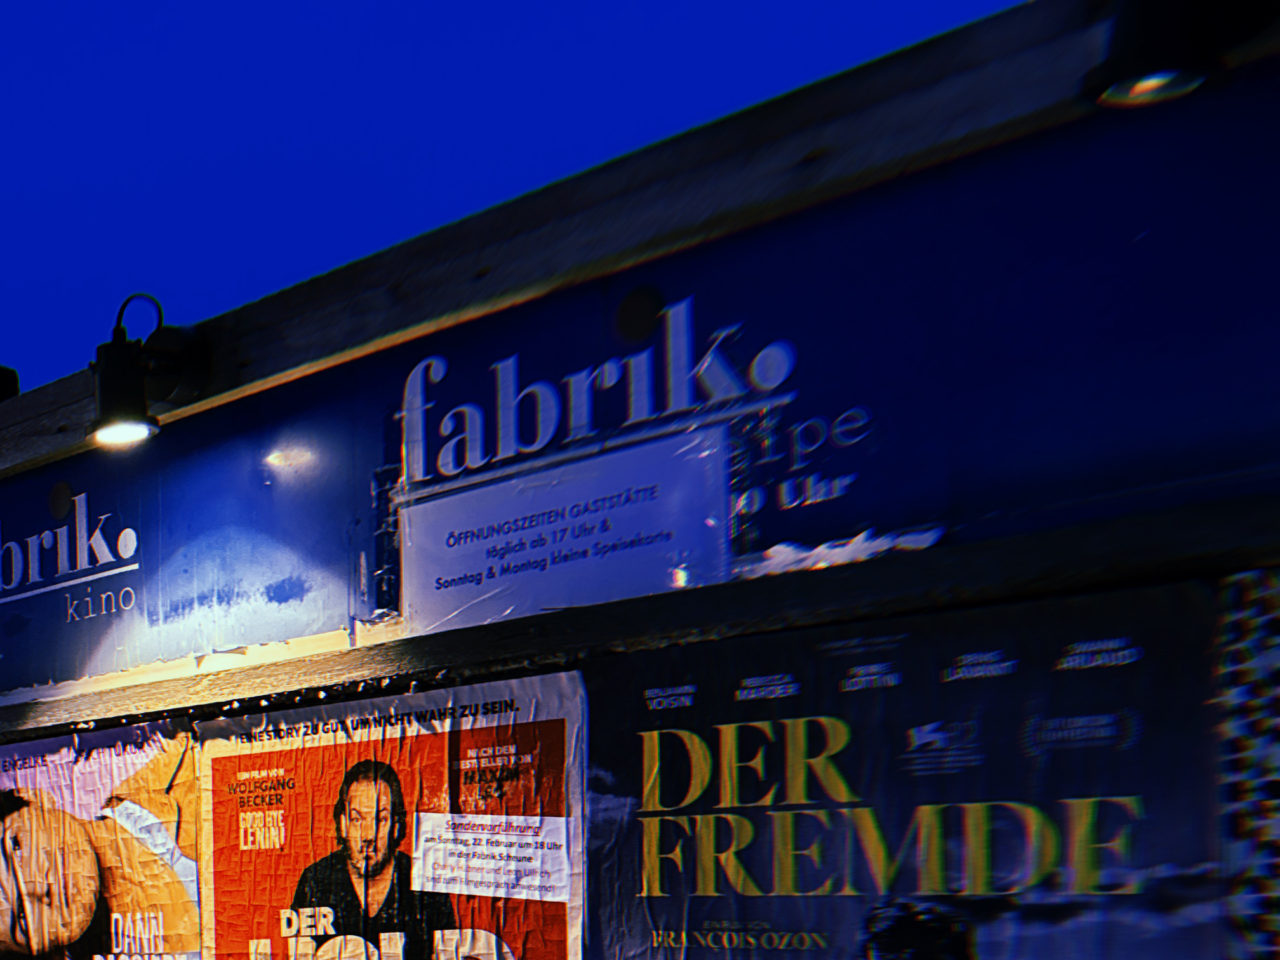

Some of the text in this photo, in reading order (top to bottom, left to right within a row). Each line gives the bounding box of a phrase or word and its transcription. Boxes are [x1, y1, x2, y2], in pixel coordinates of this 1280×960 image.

[776, 473, 860, 511] Uhr
[446, 483, 659, 548] ÖFFNUNGSZEITEN GASTSTÄTTE
[486, 518, 612, 561] täglich ab 17 Uhr &
[435, 530, 674, 590] Sonntag & Montag kleine Speisekarte
[65, 587, 136, 623] kino
[265, 725, 302, 741] STORY
[303, 722, 320, 737] ZU
[415, 706, 457, 724] WAHR
[459, 703, 479, 718] ZU
[482, 698, 520, 716] SEIN.
[646, 694, 694, 710] VOISIN
[637, 716, 862, 813] DER
[228, 778, 295, 795] WOLFGANG
[239, 794, 283, 808] BECKER
[240, 811, 264, 828] GOOD
[445, 819, 541, 836] Sondervorführung
[424, 836, 436, 844] am
[486, 838, 517, 848] Februar
[518, 841, 532, 849] um
[534, 841, 545, 850] 18
[547, 842, 563, 851] Uhr
[636, 795, 1144, 898] FREMDE
[111, 911, 164, 954] DANN
[280, 906, 335, 937] DER
[652, 930, 830, 951] FRANÇOIS OZON
